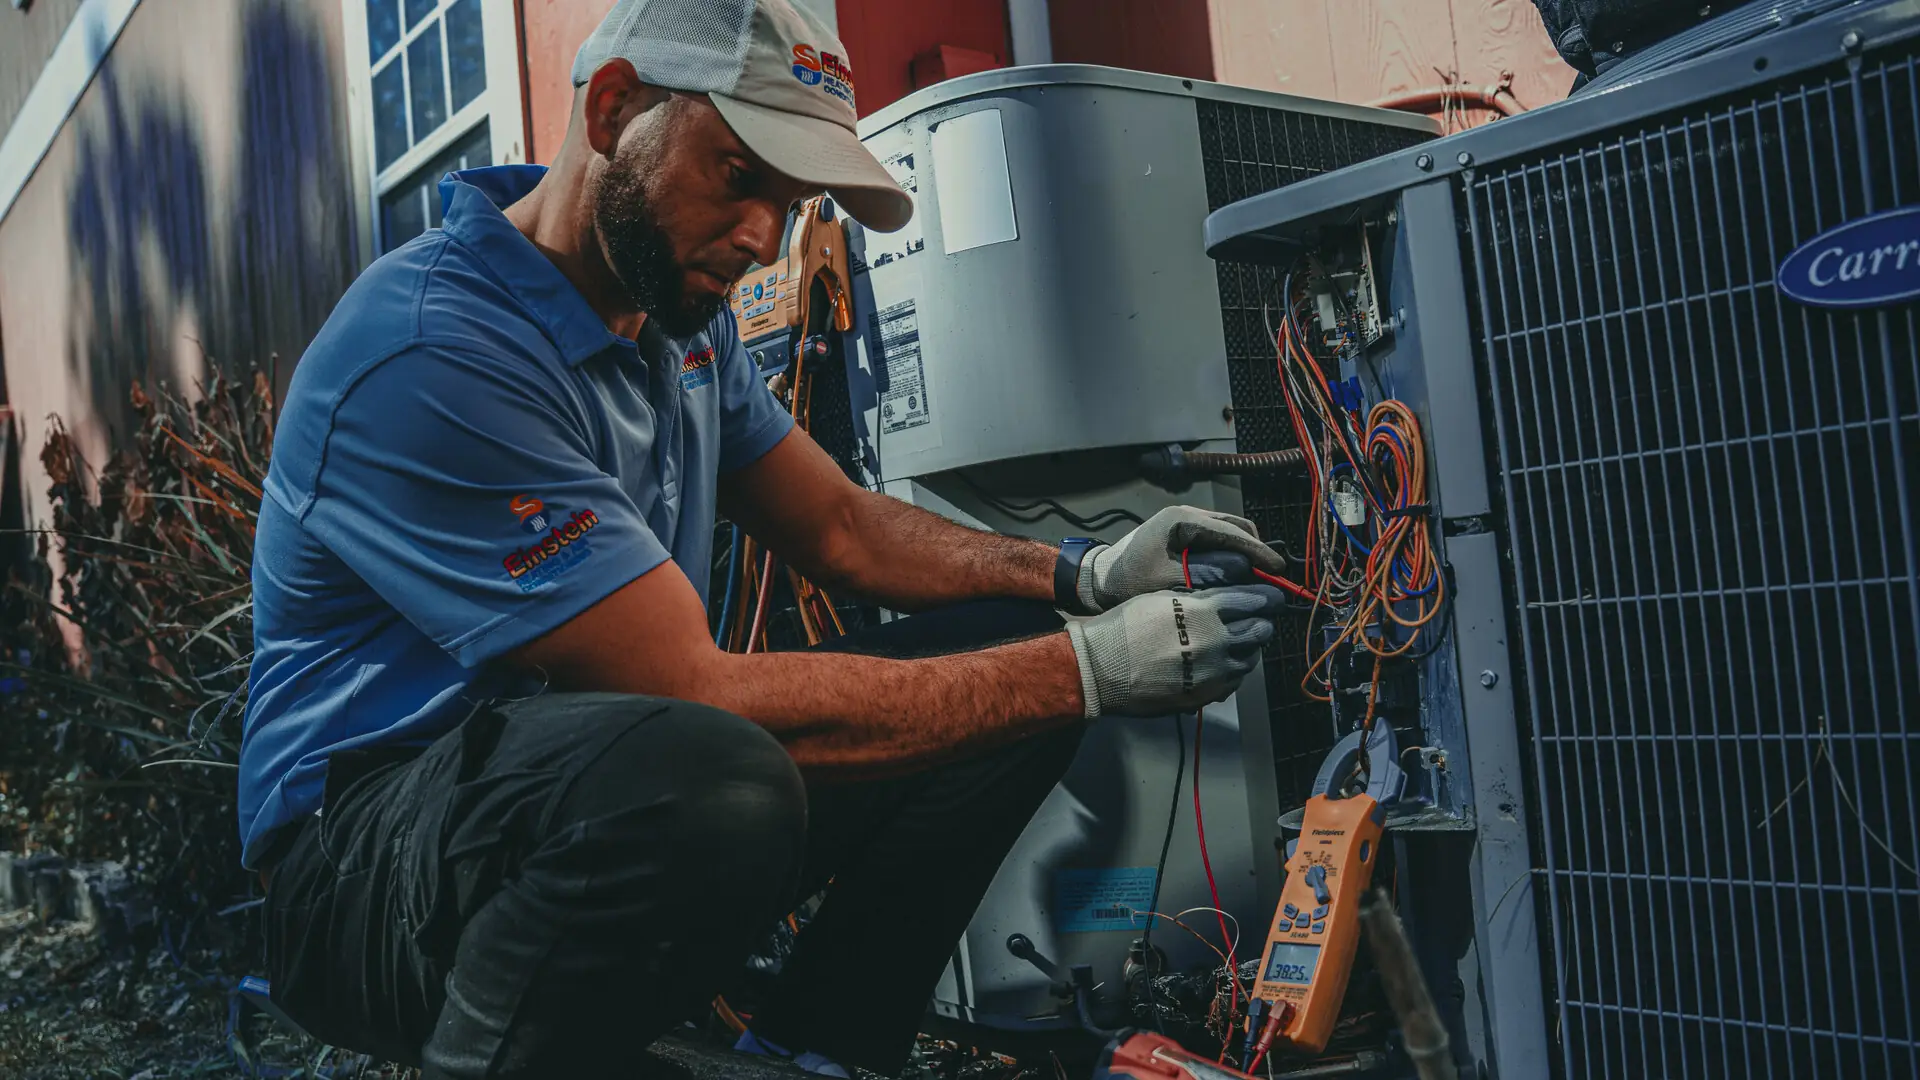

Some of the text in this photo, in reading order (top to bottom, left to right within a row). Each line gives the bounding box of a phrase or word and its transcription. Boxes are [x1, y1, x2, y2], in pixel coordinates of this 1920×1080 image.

[1808, 239, 1920, 287] Carr
[503, 508, 600, 579] Einstein
[1172, 598, 1190, 646] GRIP
[1311, 828, 1345, 837] Fieldpiece
